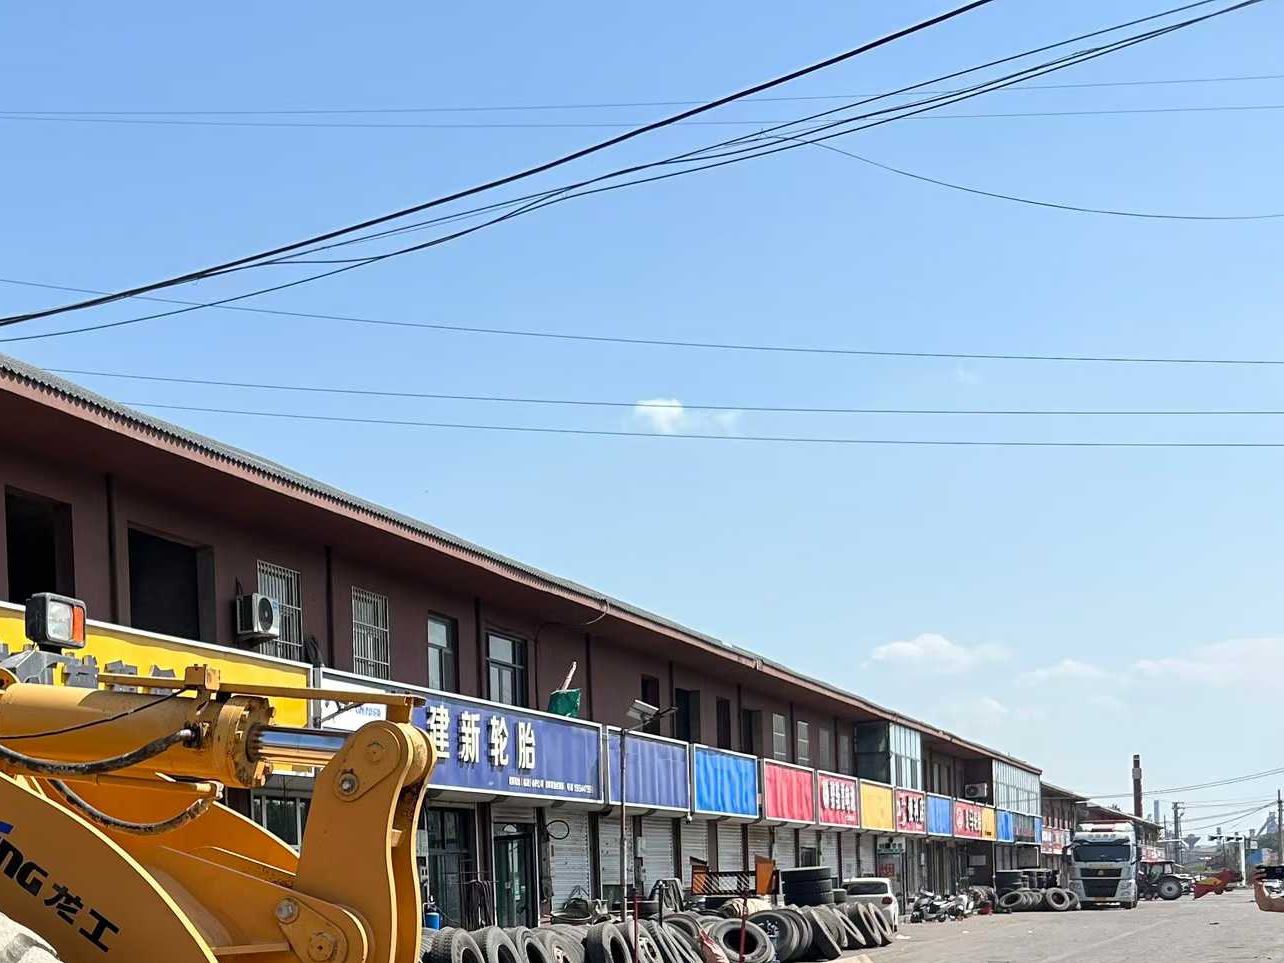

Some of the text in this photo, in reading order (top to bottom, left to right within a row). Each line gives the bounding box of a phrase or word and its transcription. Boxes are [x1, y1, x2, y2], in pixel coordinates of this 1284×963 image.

[427, 705, 536, 769] 建新轮胎
[44, 883, 120, 952] 龙工
